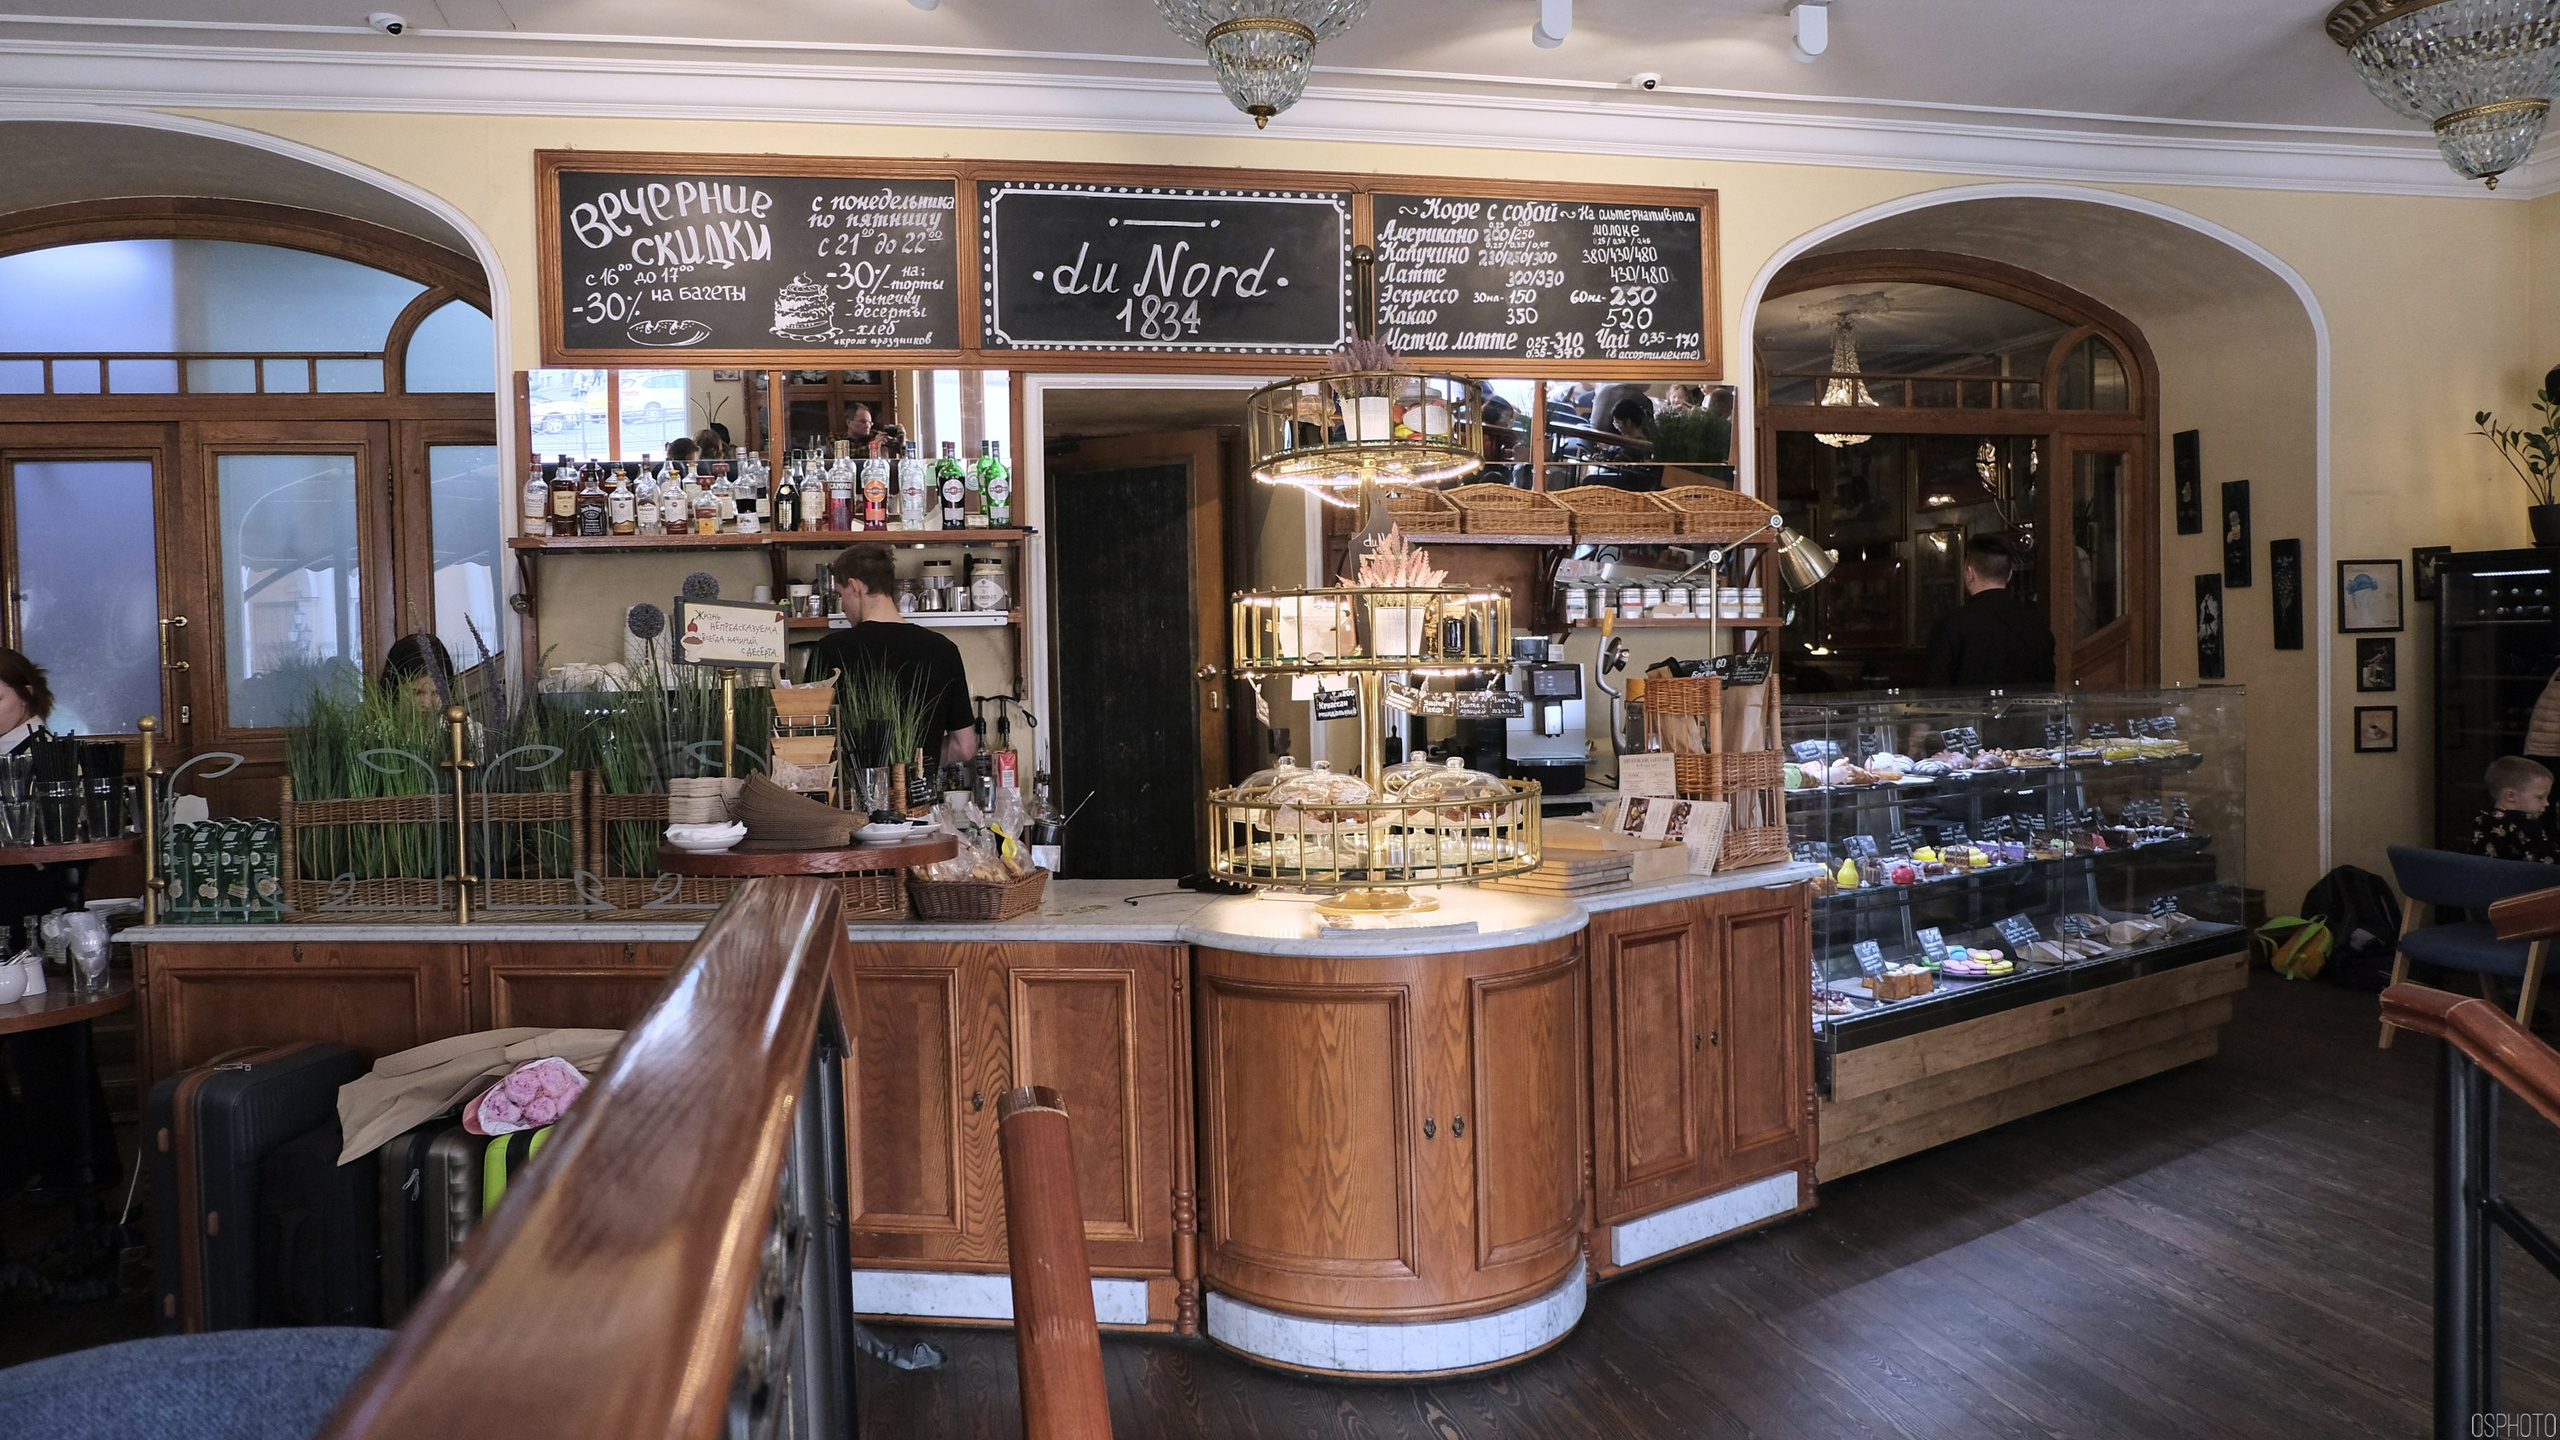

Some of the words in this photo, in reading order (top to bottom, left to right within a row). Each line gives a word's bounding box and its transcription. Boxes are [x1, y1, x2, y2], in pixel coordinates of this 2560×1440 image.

[811, 196, 823, 212] с
[830, 187, 955, 211] понедельника
[807, 213, 835, 229] по
[845, 212, 943, 233] пятницу
[1419, 197, 1481, 226] Кофе
[1486, 203, 1498, 221] с
[1502, 200, 1559, 223] собой
[1577, 204, 1595, 221] На
[1599, 207, 1696, 222] альтернативном
[1376, 218, 1480, 249] Американо
[1591, 223, 1641, 238] молоке
[817, 237, 830, 258] с
[874, 232, 897, 255] до
[1377, 241, 1471, 270] Капучино
[1581, 245, 1659, 265] 380/430/480
[634, 271, 657, 286] до
[826, 260, 892, 295] -30%
[1052, 242, 1121, 296] du
[1132, 240, 1276, 299] Nord
[1378, 262, 1448, 285] Латте
[1609, 265, 1670, 284] 430/480
[651, 288, 673, 302] на
[1379, 284, 1461, 310] Эспрессо
[1508, 289, 1538, 305] 150
[1609, 285, 1658, 307] 250
[1115, 297, 1202, 342] 1834
[1377, 303, 1439, 326] Какао
[1505, 307, 1540, 326] 350
[1601, 307, 1654, 330] 520
[870, 330, 934, 348] праздников
[1450, 331, 1520, 352] латте
[1594, 328, 1632, 350] Чай
[829, 482, 852, 490] CAMPAR
